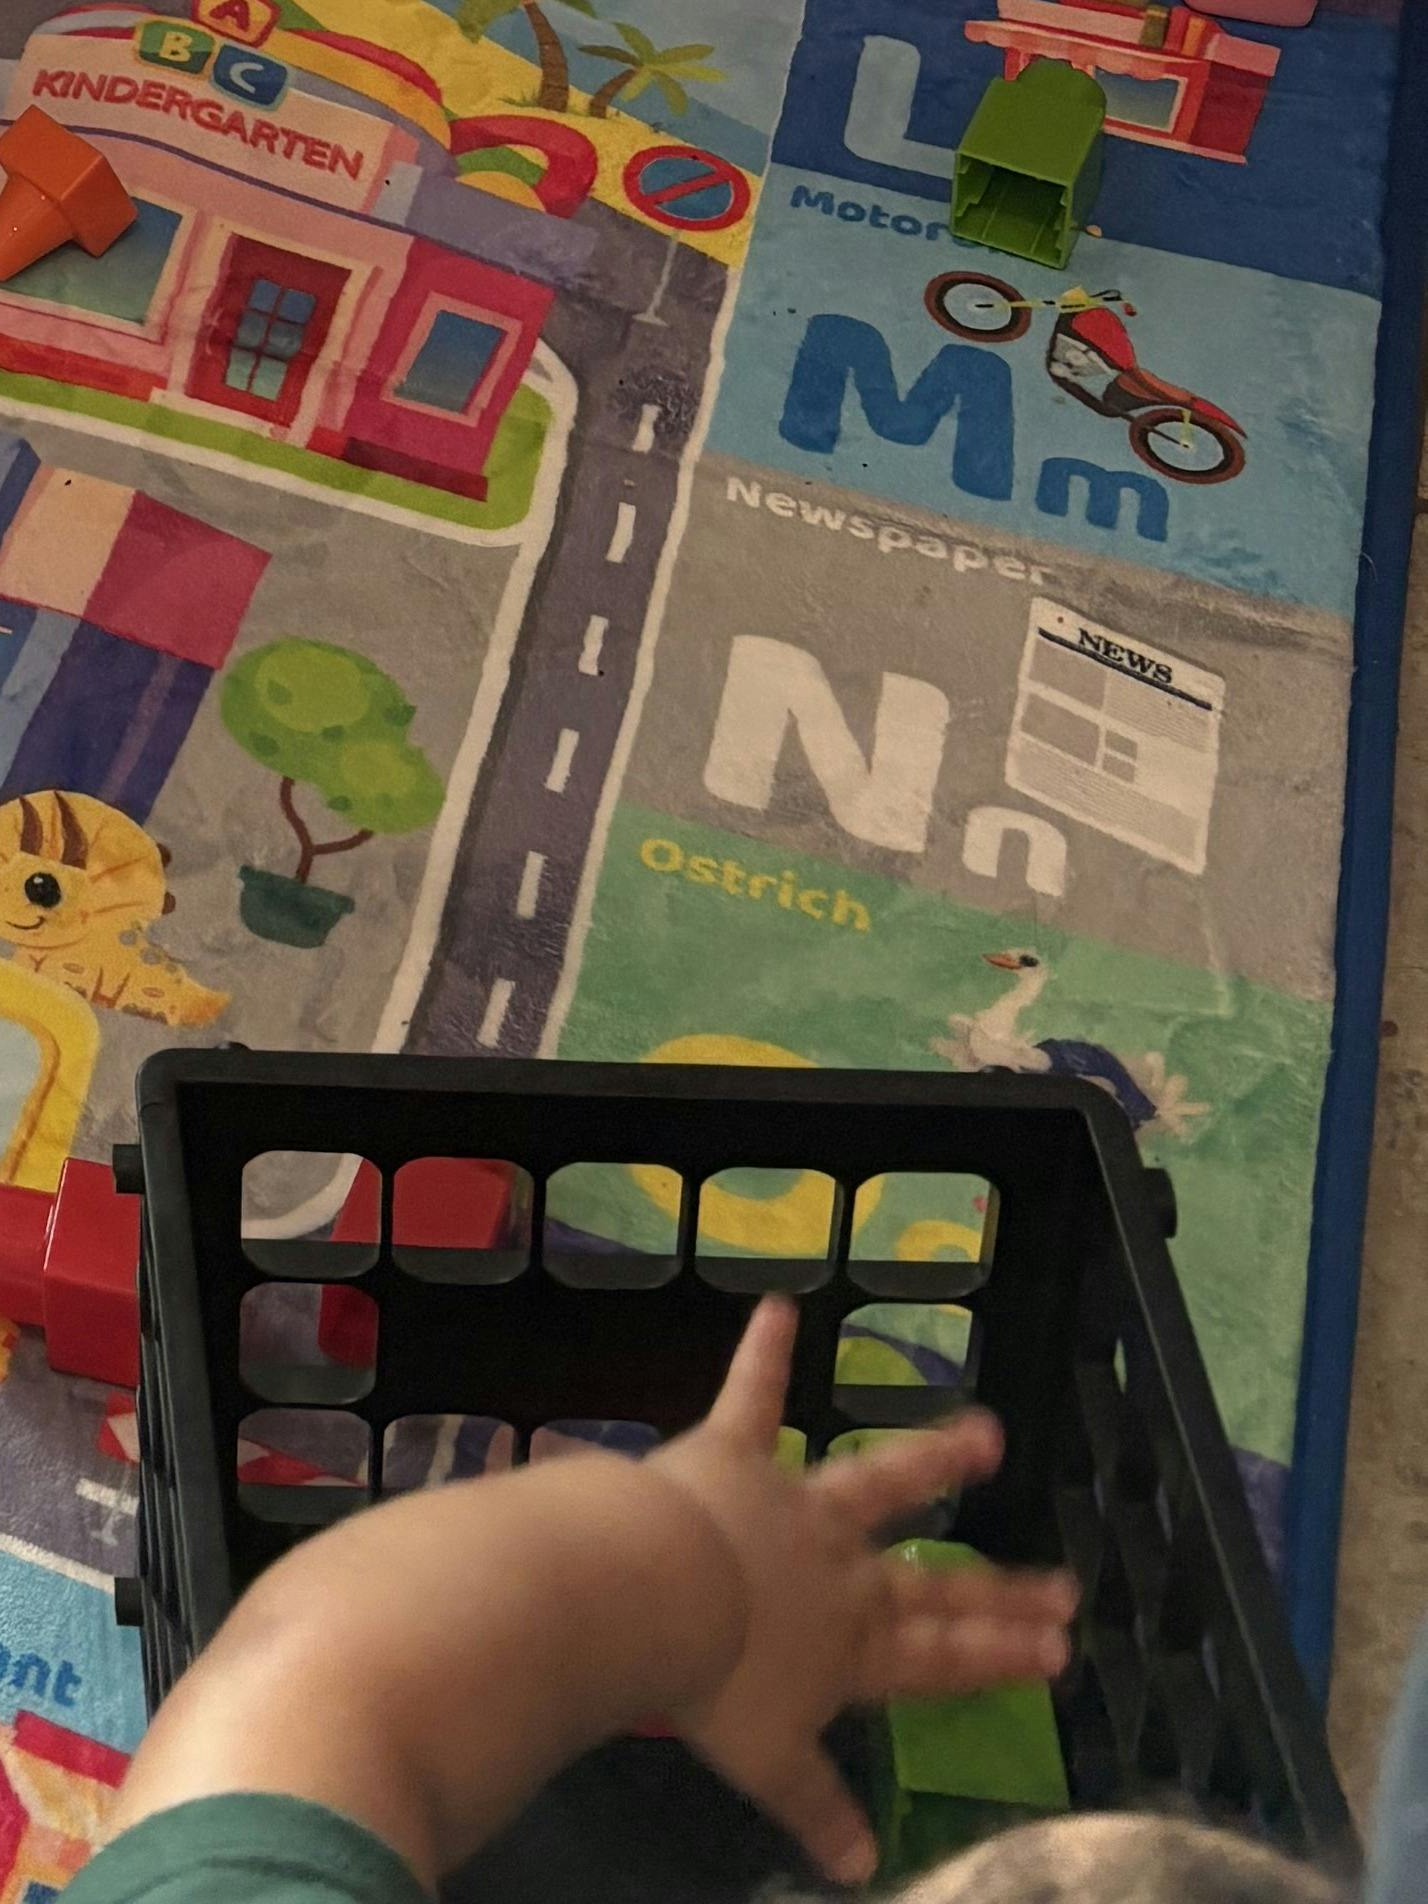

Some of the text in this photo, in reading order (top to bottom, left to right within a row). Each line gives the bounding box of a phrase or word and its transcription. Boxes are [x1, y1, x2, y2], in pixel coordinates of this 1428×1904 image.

[159, 31, 265, 94] B C
[31, 67, 365, 182] KINDERGARTEN
[726, 476, 1057, 585] Newspaper
[1078, 628, 1173, 684] NEWS
[640, 837, 871, 933] Ostrich
